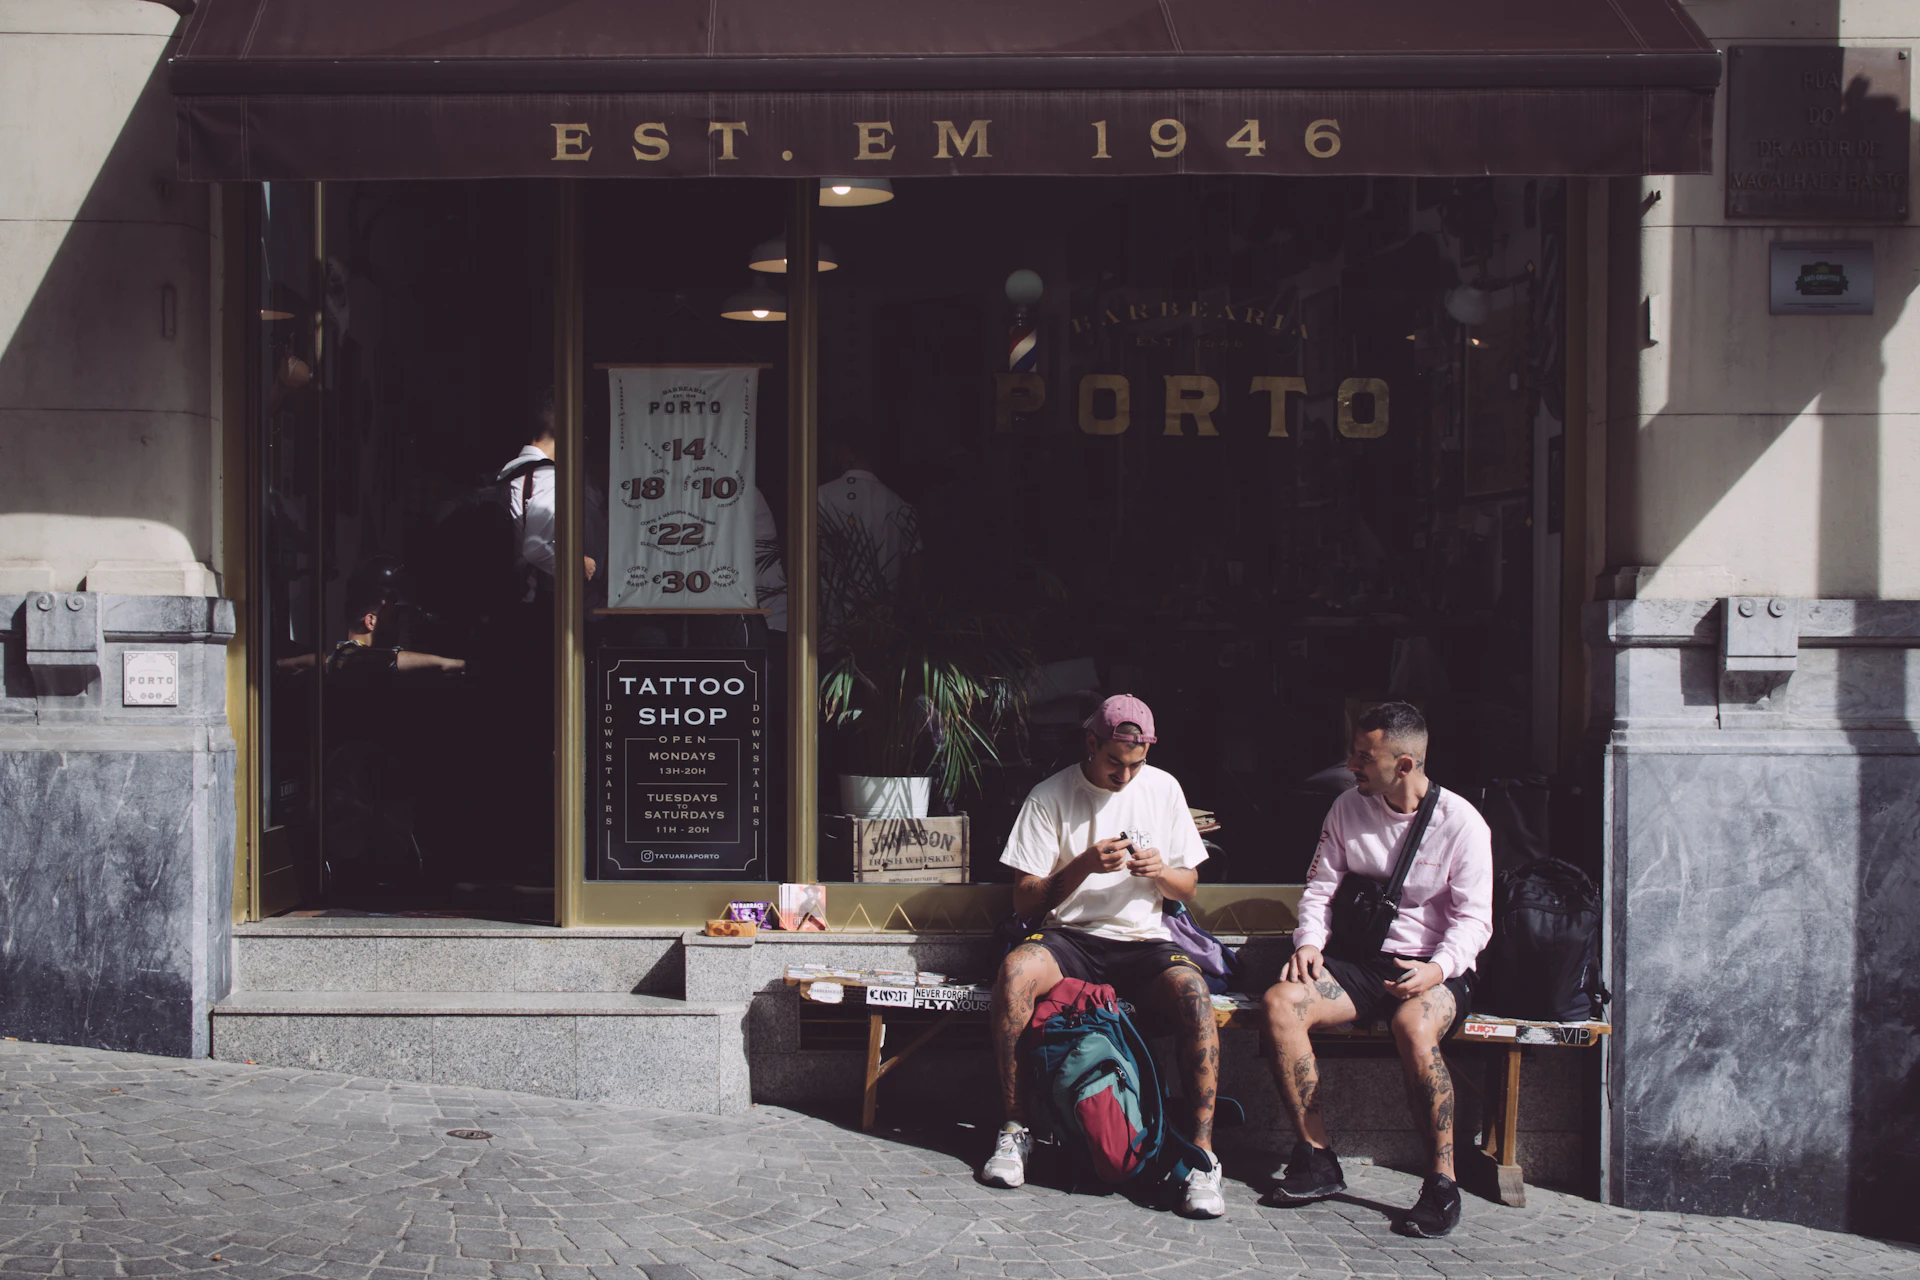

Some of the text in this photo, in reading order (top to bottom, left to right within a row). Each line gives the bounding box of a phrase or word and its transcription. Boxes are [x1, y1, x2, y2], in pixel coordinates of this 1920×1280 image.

[1808, 107, 1836, 125] DO
[551, 118, 1343, 162] EST. EM 1946
[1069, 299, 1310, 341] BARBEARIA
[662, 386, 707, 396] BARBEARIA
[648, 401, 721, 415] PORTO
[993, 373, 1391, 439] PORTO
[661, 437, 706, 461] €14
[621, 477, 666, 500] €18
[692, 477, 738, 500] €10
[648, 523, 705, 545] €22
[627, 566, 648, 574] CORTE
[711, 566, 739, 575] HAIRCUT
[652, 570, 711, 593] €30
[129, 676, 174, 685] PORTO
[619, 677, 745, 696] TATTOO
[638, 707, 728, 726] SHOP
[658, 735, 706, 744] OPEN
[649, 752, 716, 761] MONDAYS
[604, 704, 613, 826] DOWNSTAIRS
[659, 767, 706, 775] 13H-20H
[752, 704, 761, 826] DOWNSTAIRS
[647, 793, 718, 802] TUESDAYS
[644, 810, 725, 820] SATURDAYS
[655, 826, 677, 834] 11H
[688, 826, 710, 834] 20H
[869, 853, 957, 866] IRISH WHISKEY
[915, 988, 940, 998] NEVER
[1465, 1024, 1498, 1034] JUICY
[1561, 1028, 1590, 1045] VIP
